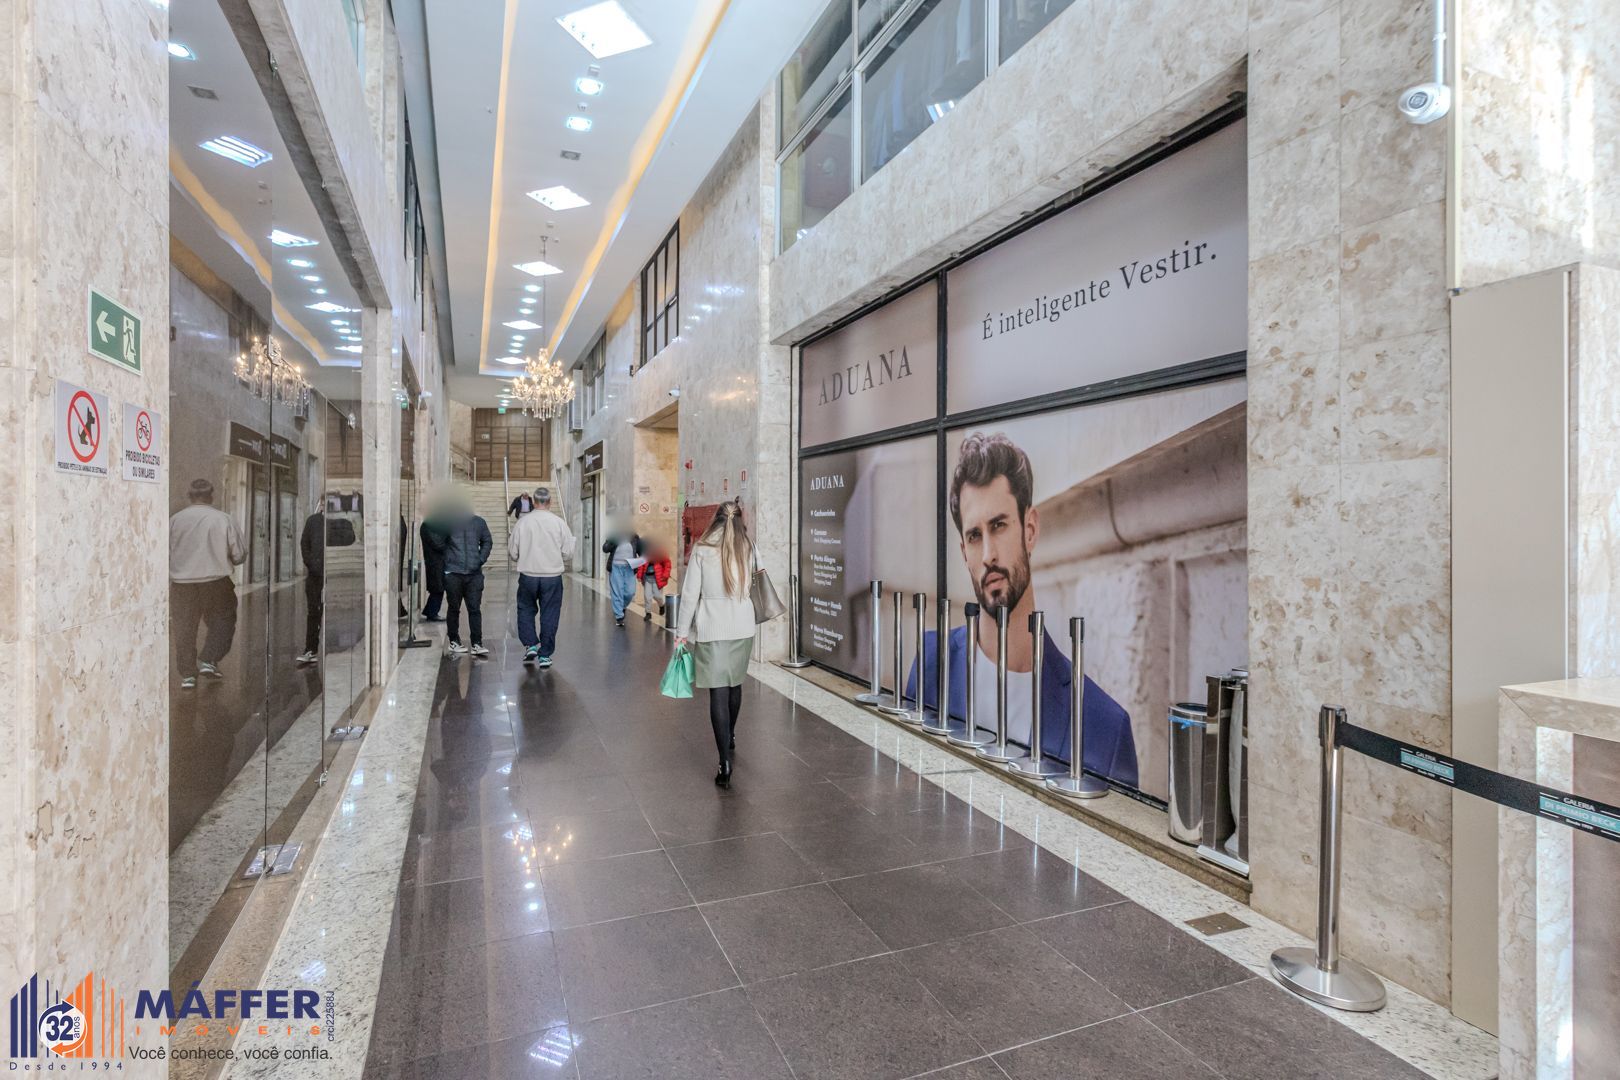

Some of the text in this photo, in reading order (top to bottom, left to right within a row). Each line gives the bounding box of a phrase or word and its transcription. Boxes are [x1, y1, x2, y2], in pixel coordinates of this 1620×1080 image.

[982, 240, 1217, 340] É inteligente Vestir.
[819, 345, 912, 406] ADUANA
[810, 475, 844, 490] ADUANA
[1563, 797, 1596, 811] GALERIA
[1591, 815, 1617, 827] BECK
